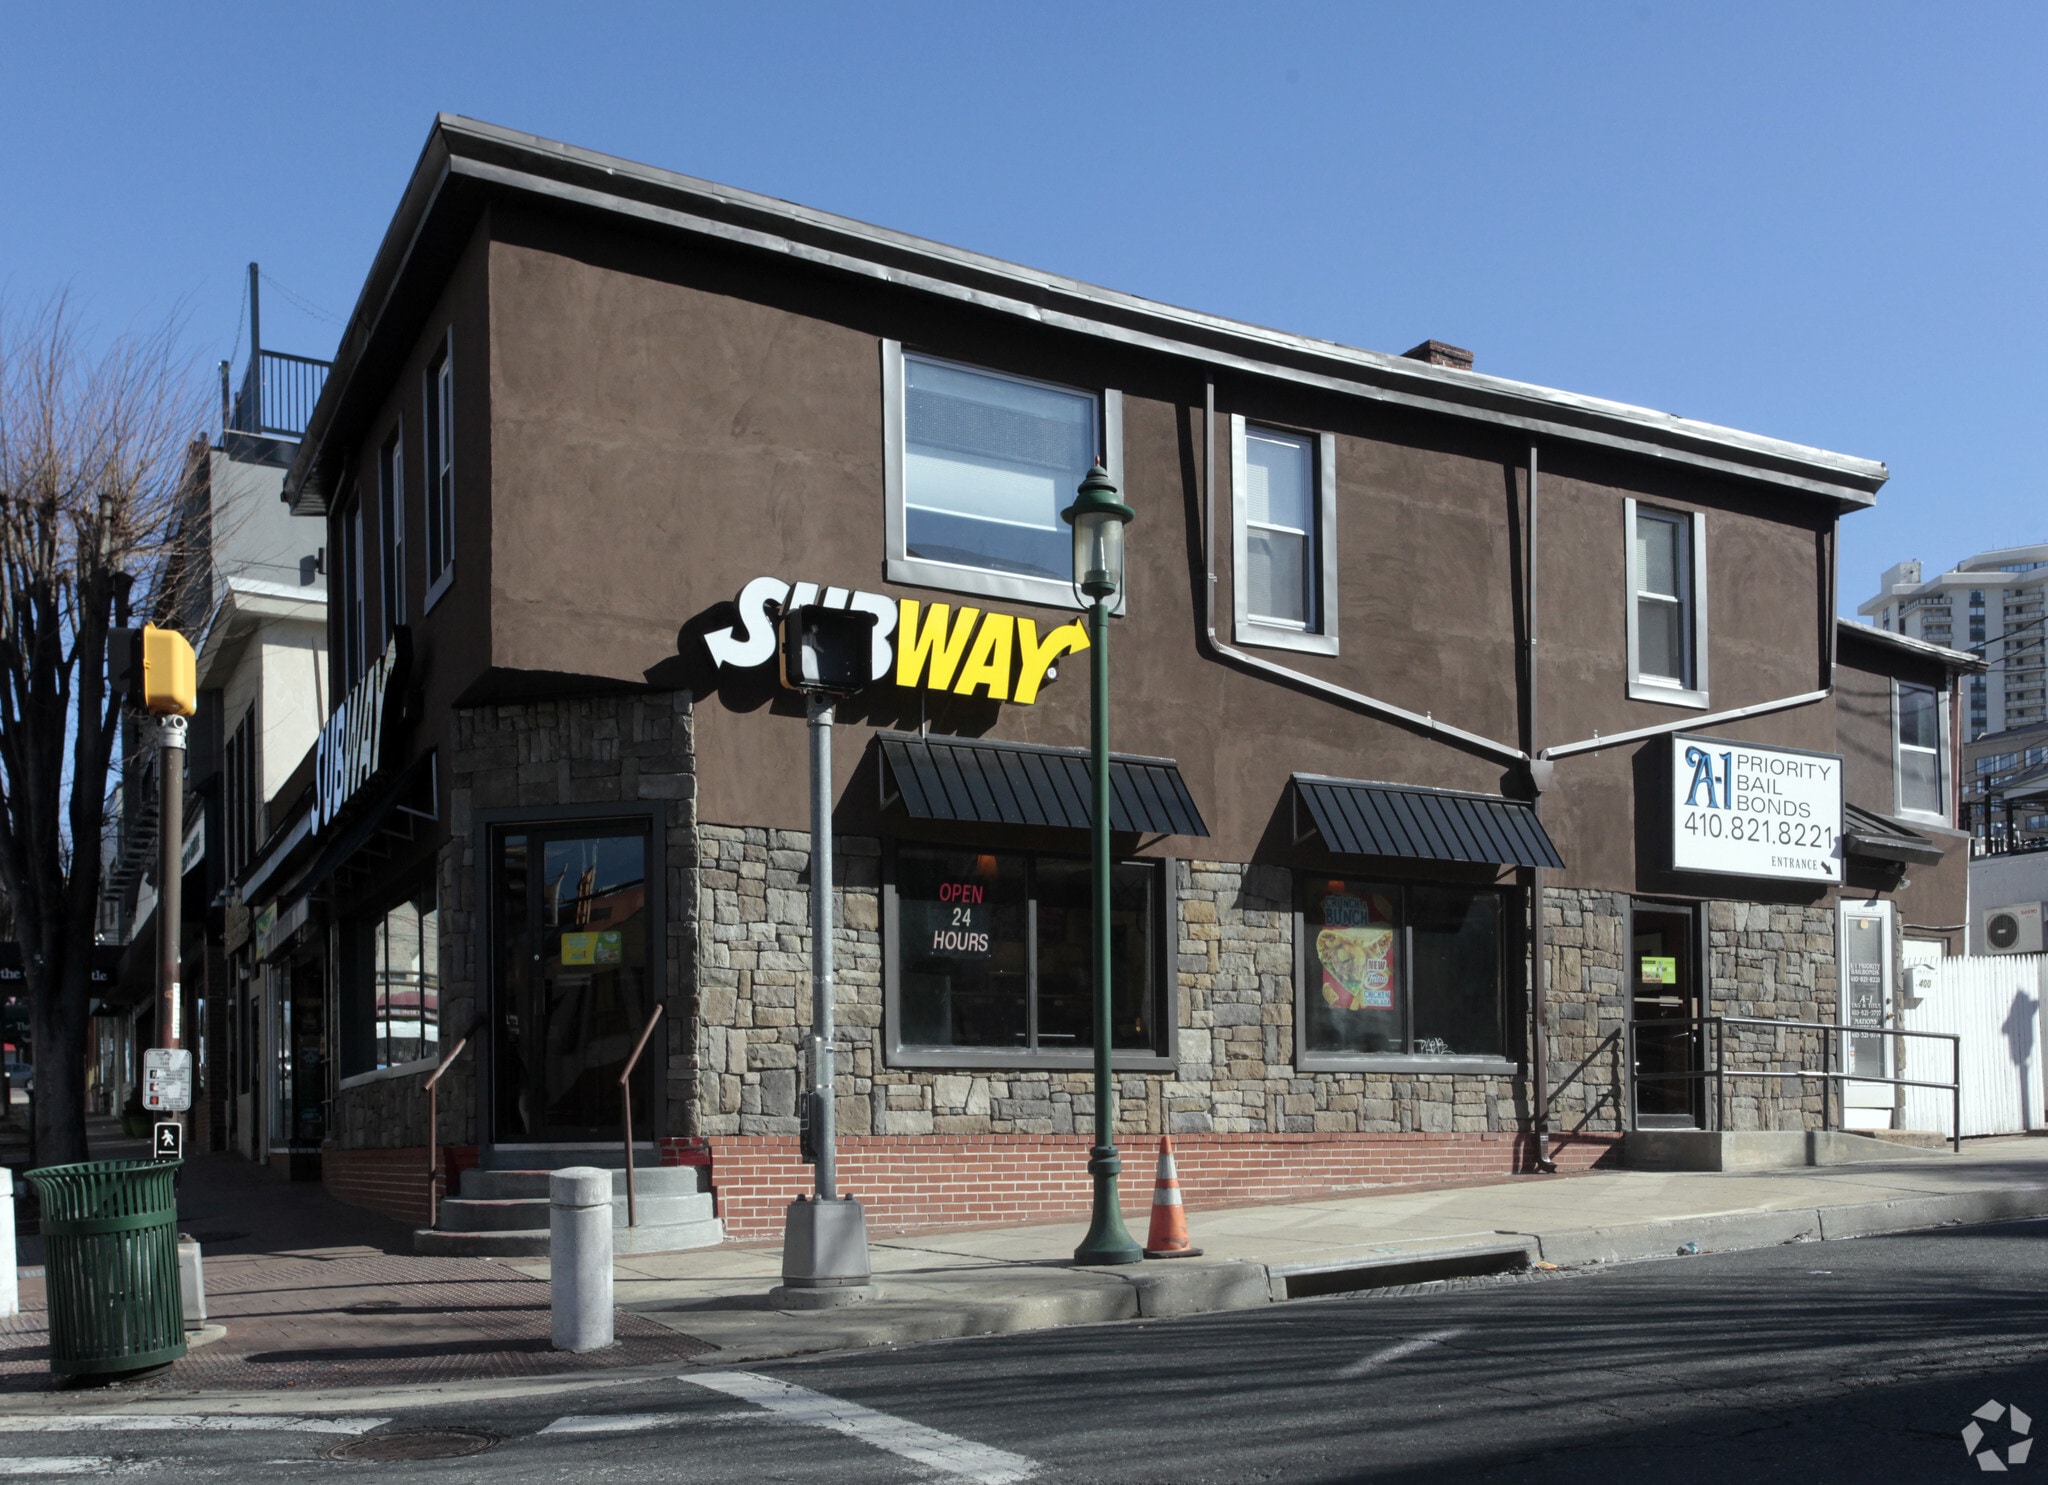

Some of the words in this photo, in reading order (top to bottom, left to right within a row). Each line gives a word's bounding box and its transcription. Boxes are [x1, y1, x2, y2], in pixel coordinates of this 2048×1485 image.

[310, 632, 397, 836] SUBWAY
[1737, 753, 1831, 781] PRIORITY
[1684, 745, 1732, 811] A-1
[1737, 774, 1783, 796] BAIL
[1737, 794, 1811, 819] BONDS
[1684, 811, 1832, 849] 410.821.8221
[1771, 855, 1818, 871] ENTRANCE
[939, 882, 983, 904] OPEN
[951, 907, 972, 927] 24
[1325, 908, 1368, 925] BUNCH
[933, 930, 989, 952] HOURS
[0, 968, 21, 979] the
[1368, 960, 1386, 970] NEW
[1364, 990, 1391, 999] CHICKEN
[1918, 979, 1932, 989] 400
[1858, 994, 1873, 1003] A-1
